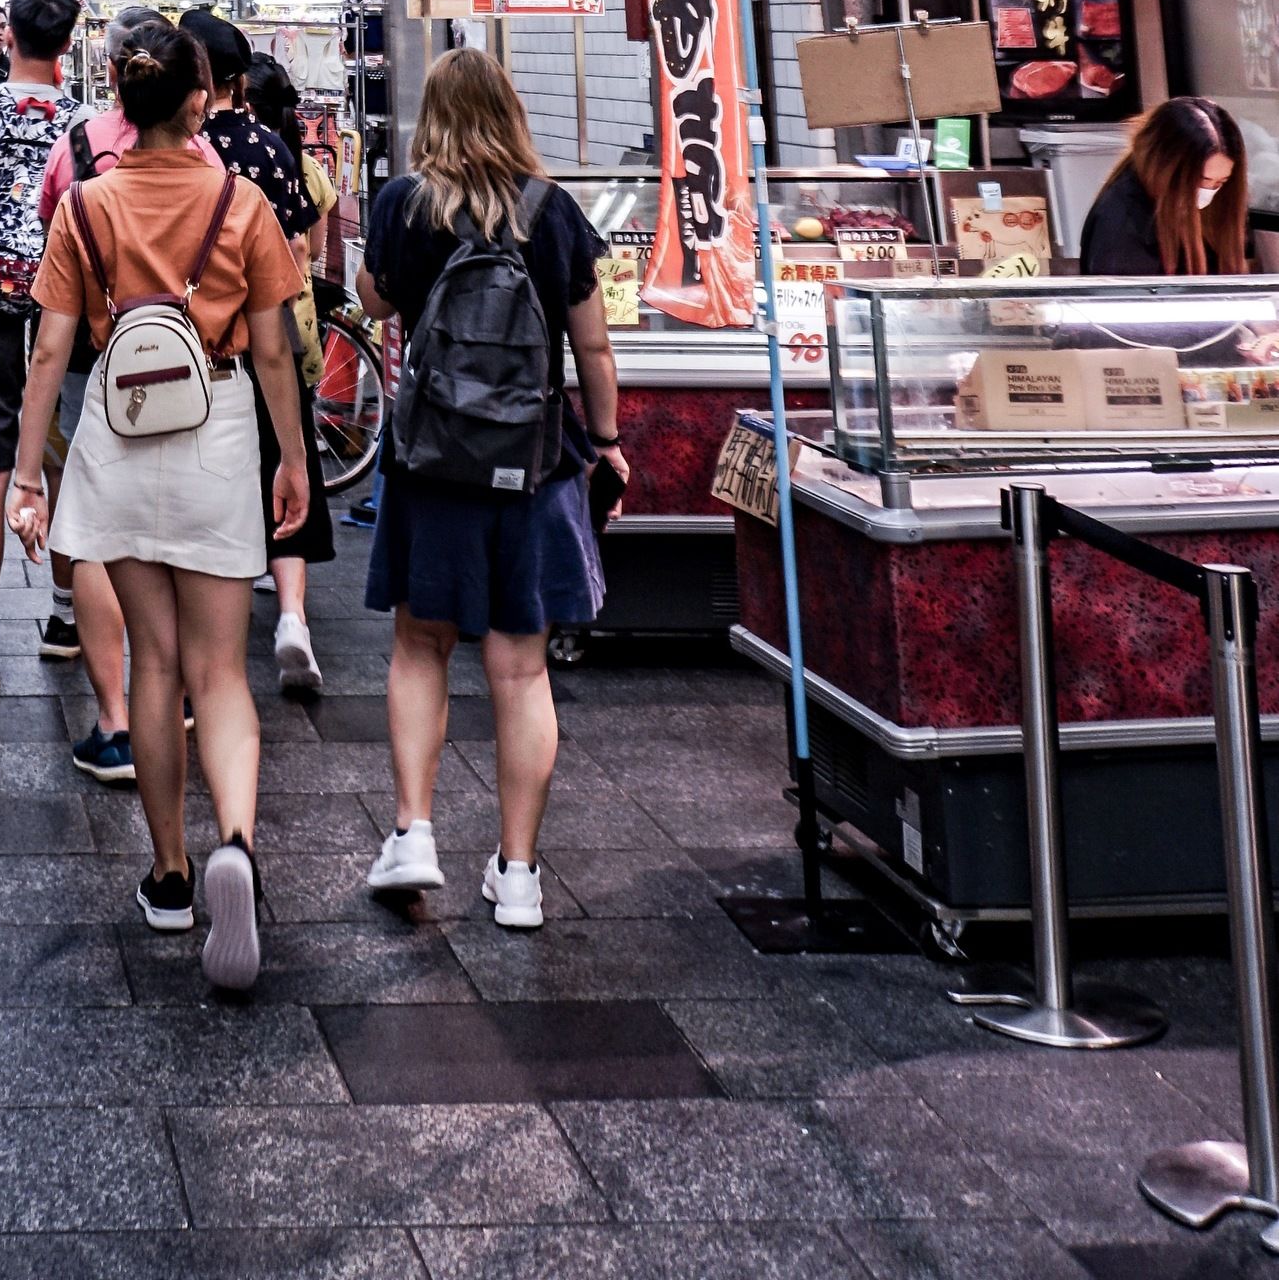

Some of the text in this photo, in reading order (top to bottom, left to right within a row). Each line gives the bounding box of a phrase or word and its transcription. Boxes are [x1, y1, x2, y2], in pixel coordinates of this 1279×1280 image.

[866, 246, 896, 260] 900
[781, 265, 838, 282] お買得品
[789, 332, 824, 363] 98
[1007, 374, 1061, 384] HIMALAYAN
[1104, 377, 1160, 386] HIMALAYAN
